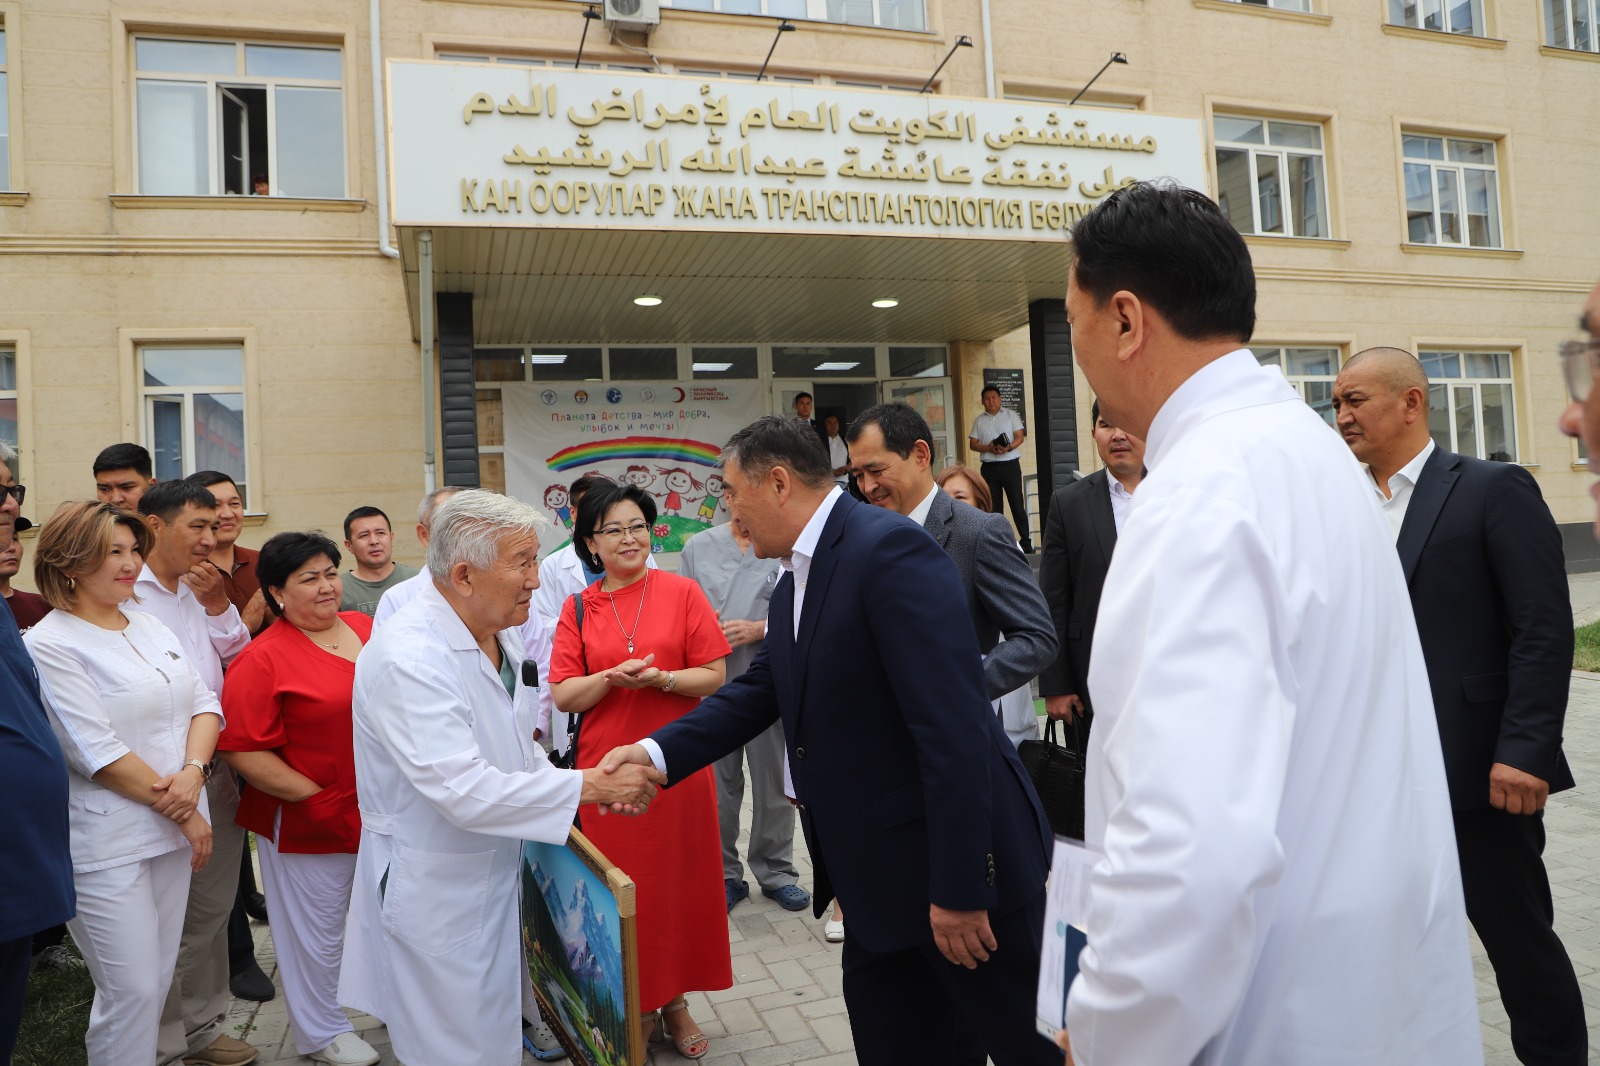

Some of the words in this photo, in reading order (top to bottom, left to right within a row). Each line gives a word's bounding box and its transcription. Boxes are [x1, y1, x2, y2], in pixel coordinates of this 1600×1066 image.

[463, 83, 557, 125] الدم
[567, 84, 729, 130] لأمراض
[740, 97, 839, 137] العام
[849, 109, 977, 144] الكويت
[984, 111, 1158, 153] مستشفى
[503, 131, 670, 177] الرشيد
[838, 146, 974, 184] عائشة
[983, 155, 1072, 189] نفقة
[460, 177, 522, 213] КАН
[529, 179, 666, 216] ООРУЛАР
[672, 184, 758, 219] ЖАНА
[761, 187, 1025, 229] ТРАНСПЛАНТОЛОГИЯ
[551, 412, 597, 422] Планета
[601, 411, 643, 422] Детства
